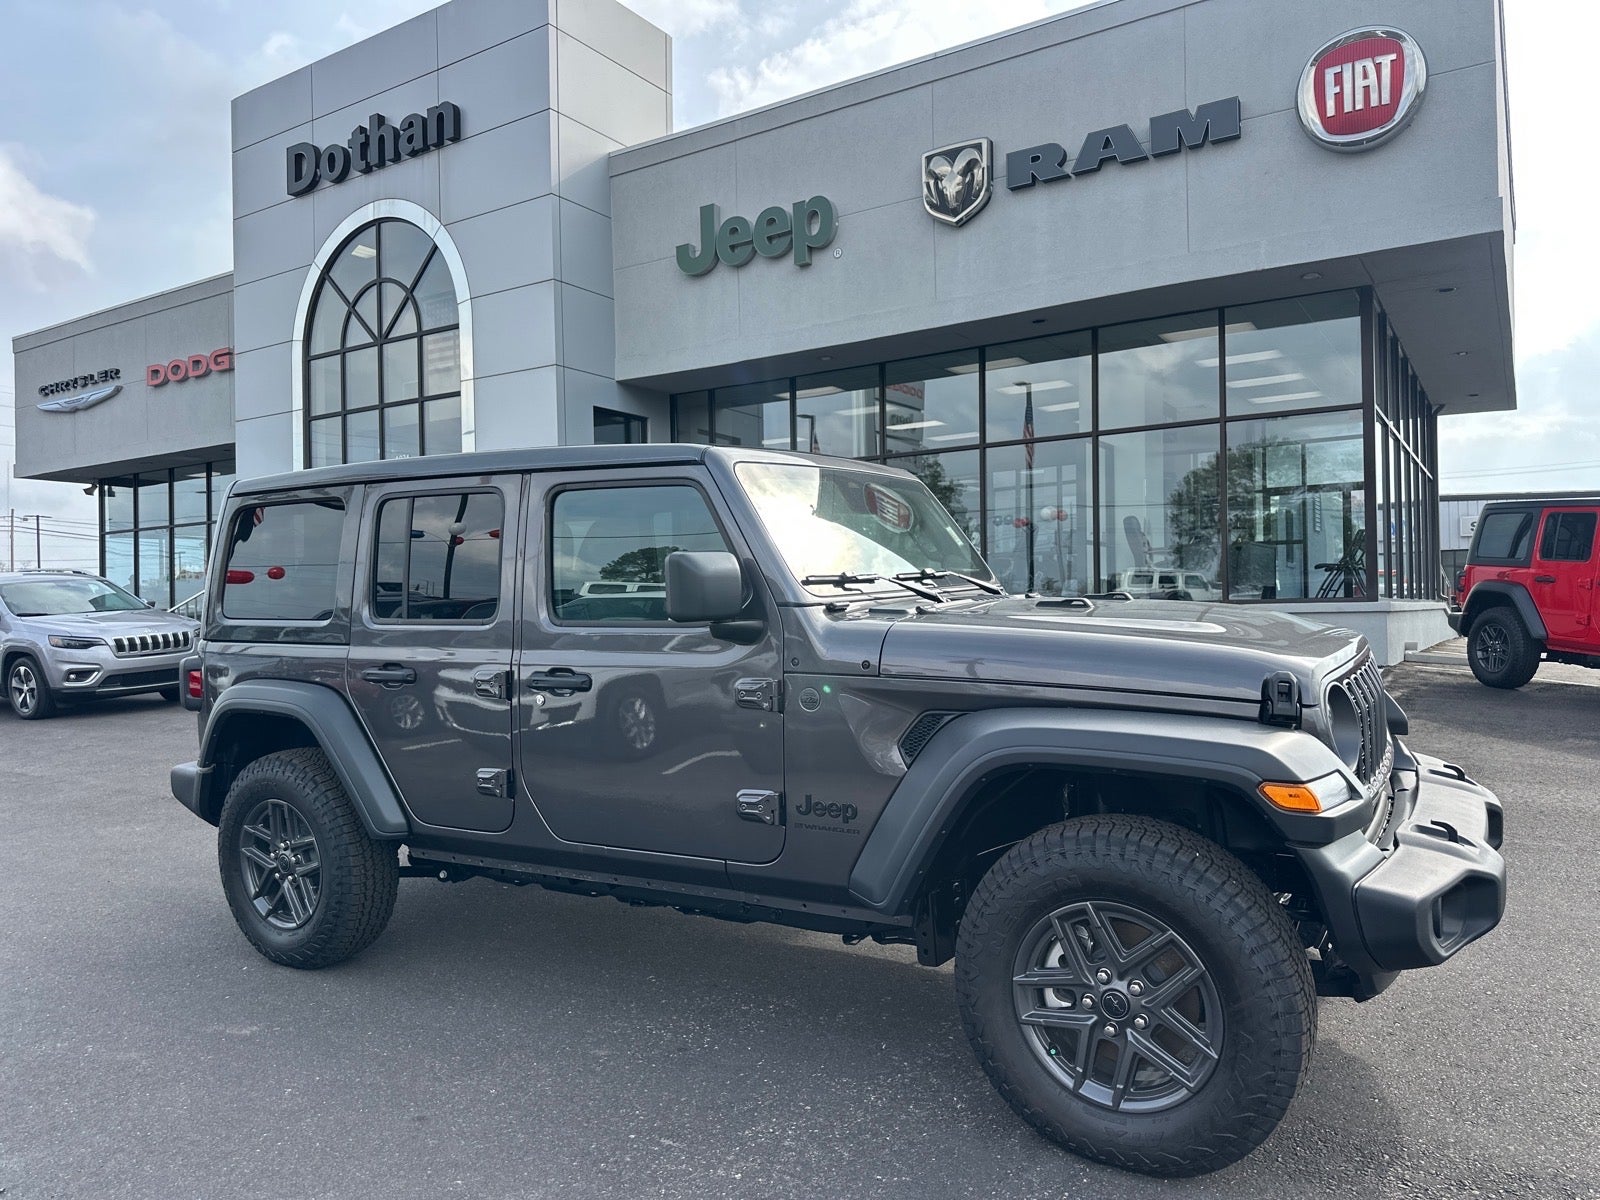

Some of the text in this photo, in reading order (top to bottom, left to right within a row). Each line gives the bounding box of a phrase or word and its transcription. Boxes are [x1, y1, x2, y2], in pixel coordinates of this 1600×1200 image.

[1324, 53, 1397, 118] FIAT
[286, 101, 461, 198] Dothan
[1006, 96, 1241, 191] RAM
[676, 195, 838, 276] Jeep
[38, 368, 121, 397] CHRYSLER
[146, 347, 234, 387] DODG
[796, 793, 858, 824] Jeep
